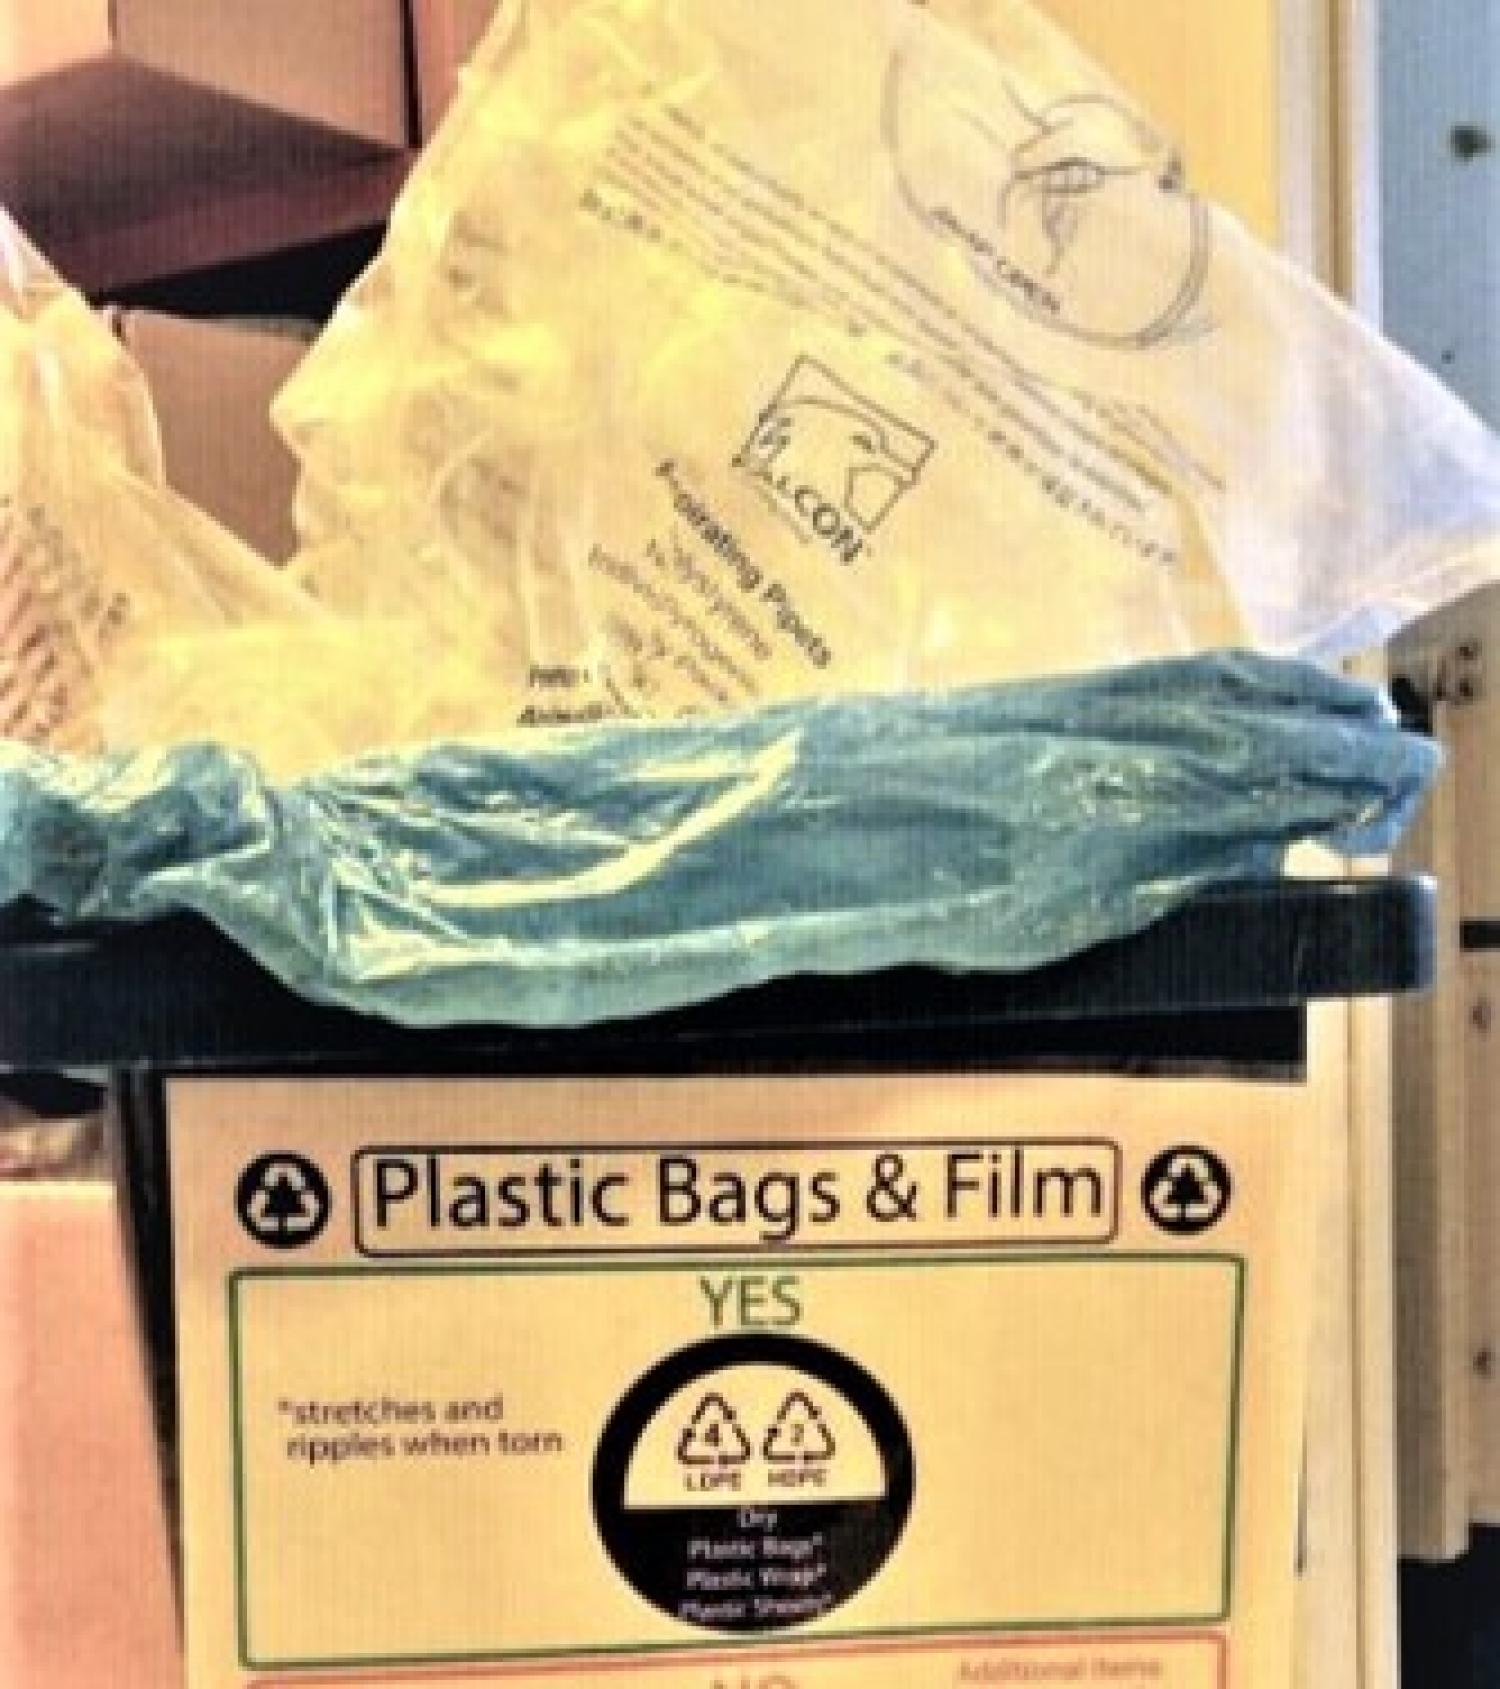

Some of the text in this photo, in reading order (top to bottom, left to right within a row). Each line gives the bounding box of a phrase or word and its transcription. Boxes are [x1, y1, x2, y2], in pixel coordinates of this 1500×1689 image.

[372, 1144, 1103, 1243] Plastic Bags & Film
[699, 1275, 803, 1329] YES
[444, 1392, 504, 1425] and
[286, 1428, 562, 1468] ripples when torn
